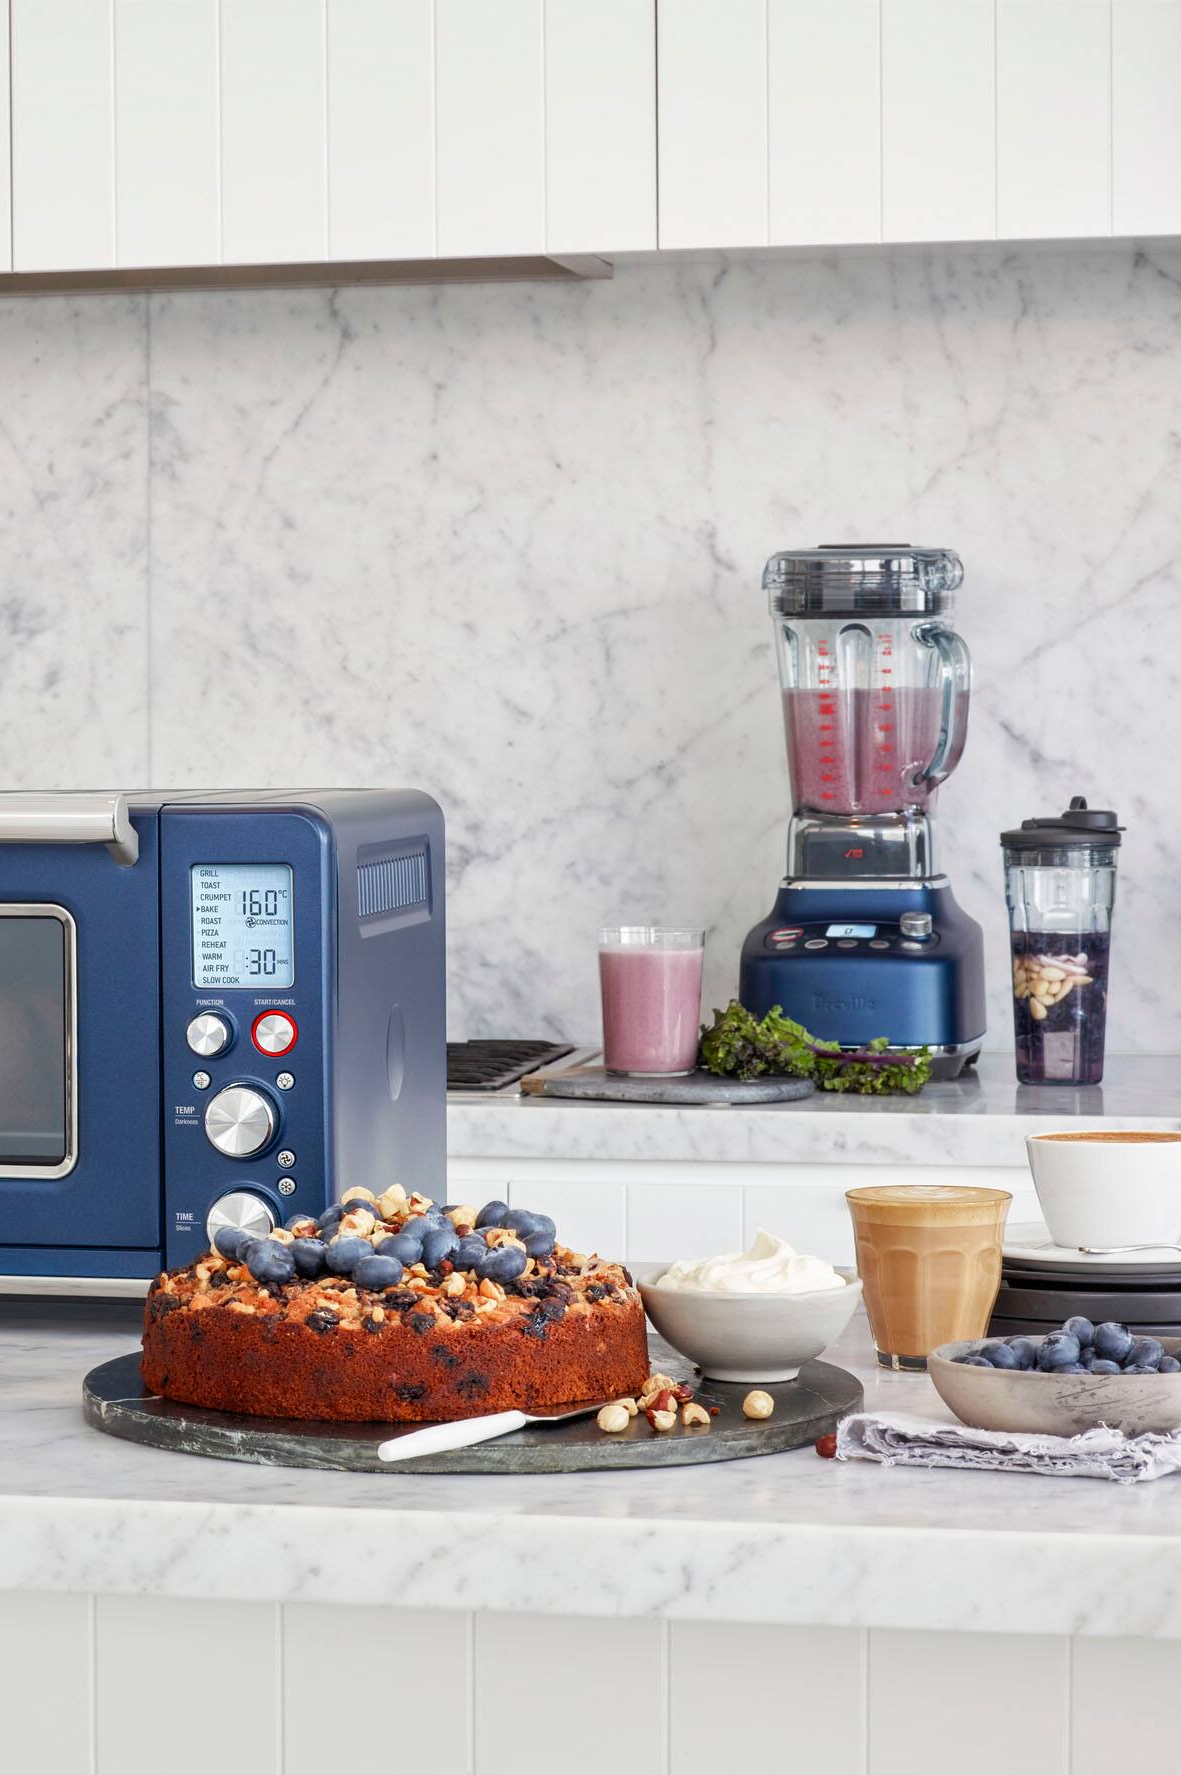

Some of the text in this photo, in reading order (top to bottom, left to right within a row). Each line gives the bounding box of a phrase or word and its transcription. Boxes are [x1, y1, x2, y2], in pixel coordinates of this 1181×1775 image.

[200, 869, 218, 877] GRILL
[200, 881, 221, 890] TOAST
[200, 893, 232, 902] CRUMPET
[242, 889, 278, 916] 160
[200, 905, 219, 914] BAKE
[200, 917, 222, 925] ROAST
[256, 918, 289, 927] CONVECTION
[201, 929, 219, 937] PIZZA
[201, 941, 227, 949] REHEAT
[202, 952, 223, 961] WARM
[202, 964, 230, 973] AIR FRY
[202, 976, 240, 985] SLOW COOK
[175, 1106, 195, 1115] TEMP
[175, 1212, 194, 1221] TIME
